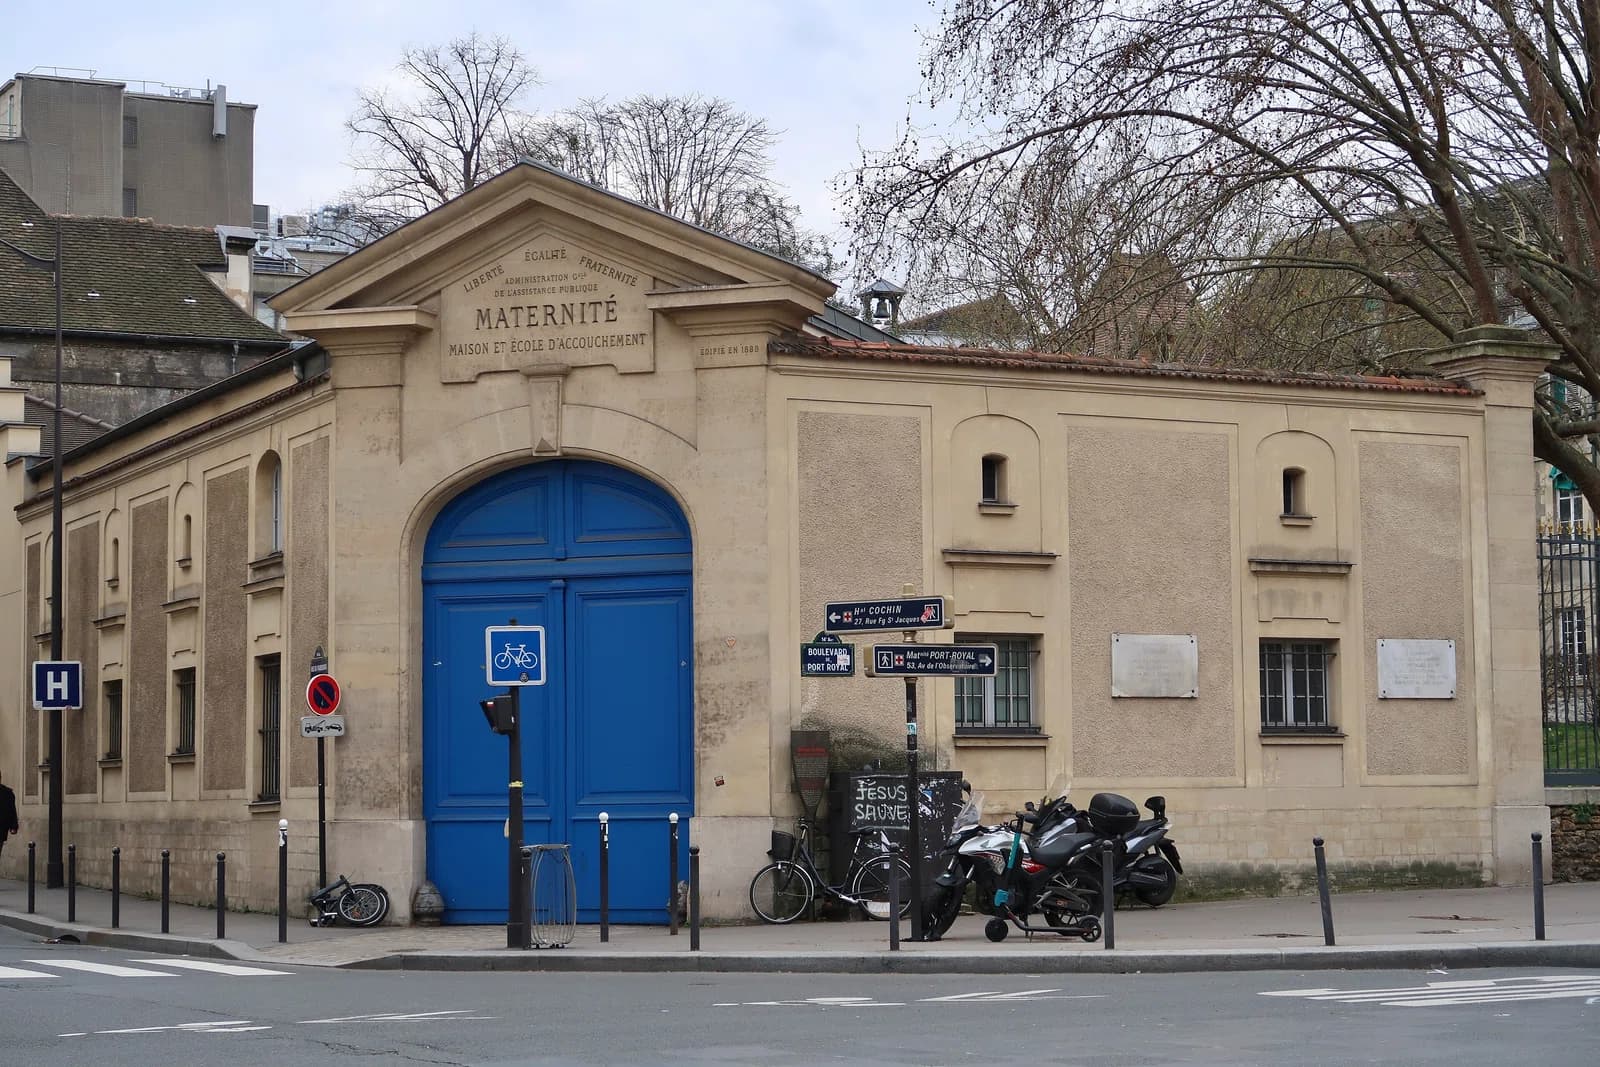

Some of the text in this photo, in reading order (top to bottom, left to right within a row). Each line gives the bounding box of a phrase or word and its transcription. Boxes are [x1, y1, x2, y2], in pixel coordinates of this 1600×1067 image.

[524, 246, 567, 262] ÉGALITÉ
[579, 256, 638, 287] FRATERNITÉ
[505, 273, 569, 285] ADMINISTRATION
[494, 283, 599, 298] DE L'ASSISTANCE PUBLIQUE
[475, 294, 618, 330] MATERNITÉ
[449, 332, 648, 356] MAISON ET ÉCOLE D'ACCOUCHEMENT
[728, 345, 739, 355] EN
[869, 605, 902, 615] COCHIN
[865, 617, 877, 625] Rue
[878, 616, 886, 626] Fg
[895, 616, 920, 625] Jacques
[807, 647, 848, 656] BOULEVARD
[929, 650, 976, 660] PORT-ROYAL
[807, 663, 849, 672] PORT ROYAL
[917, 662, 926, 670] Av
[927, 662, 934, 670] de
[47, 671, 69, 700] H
